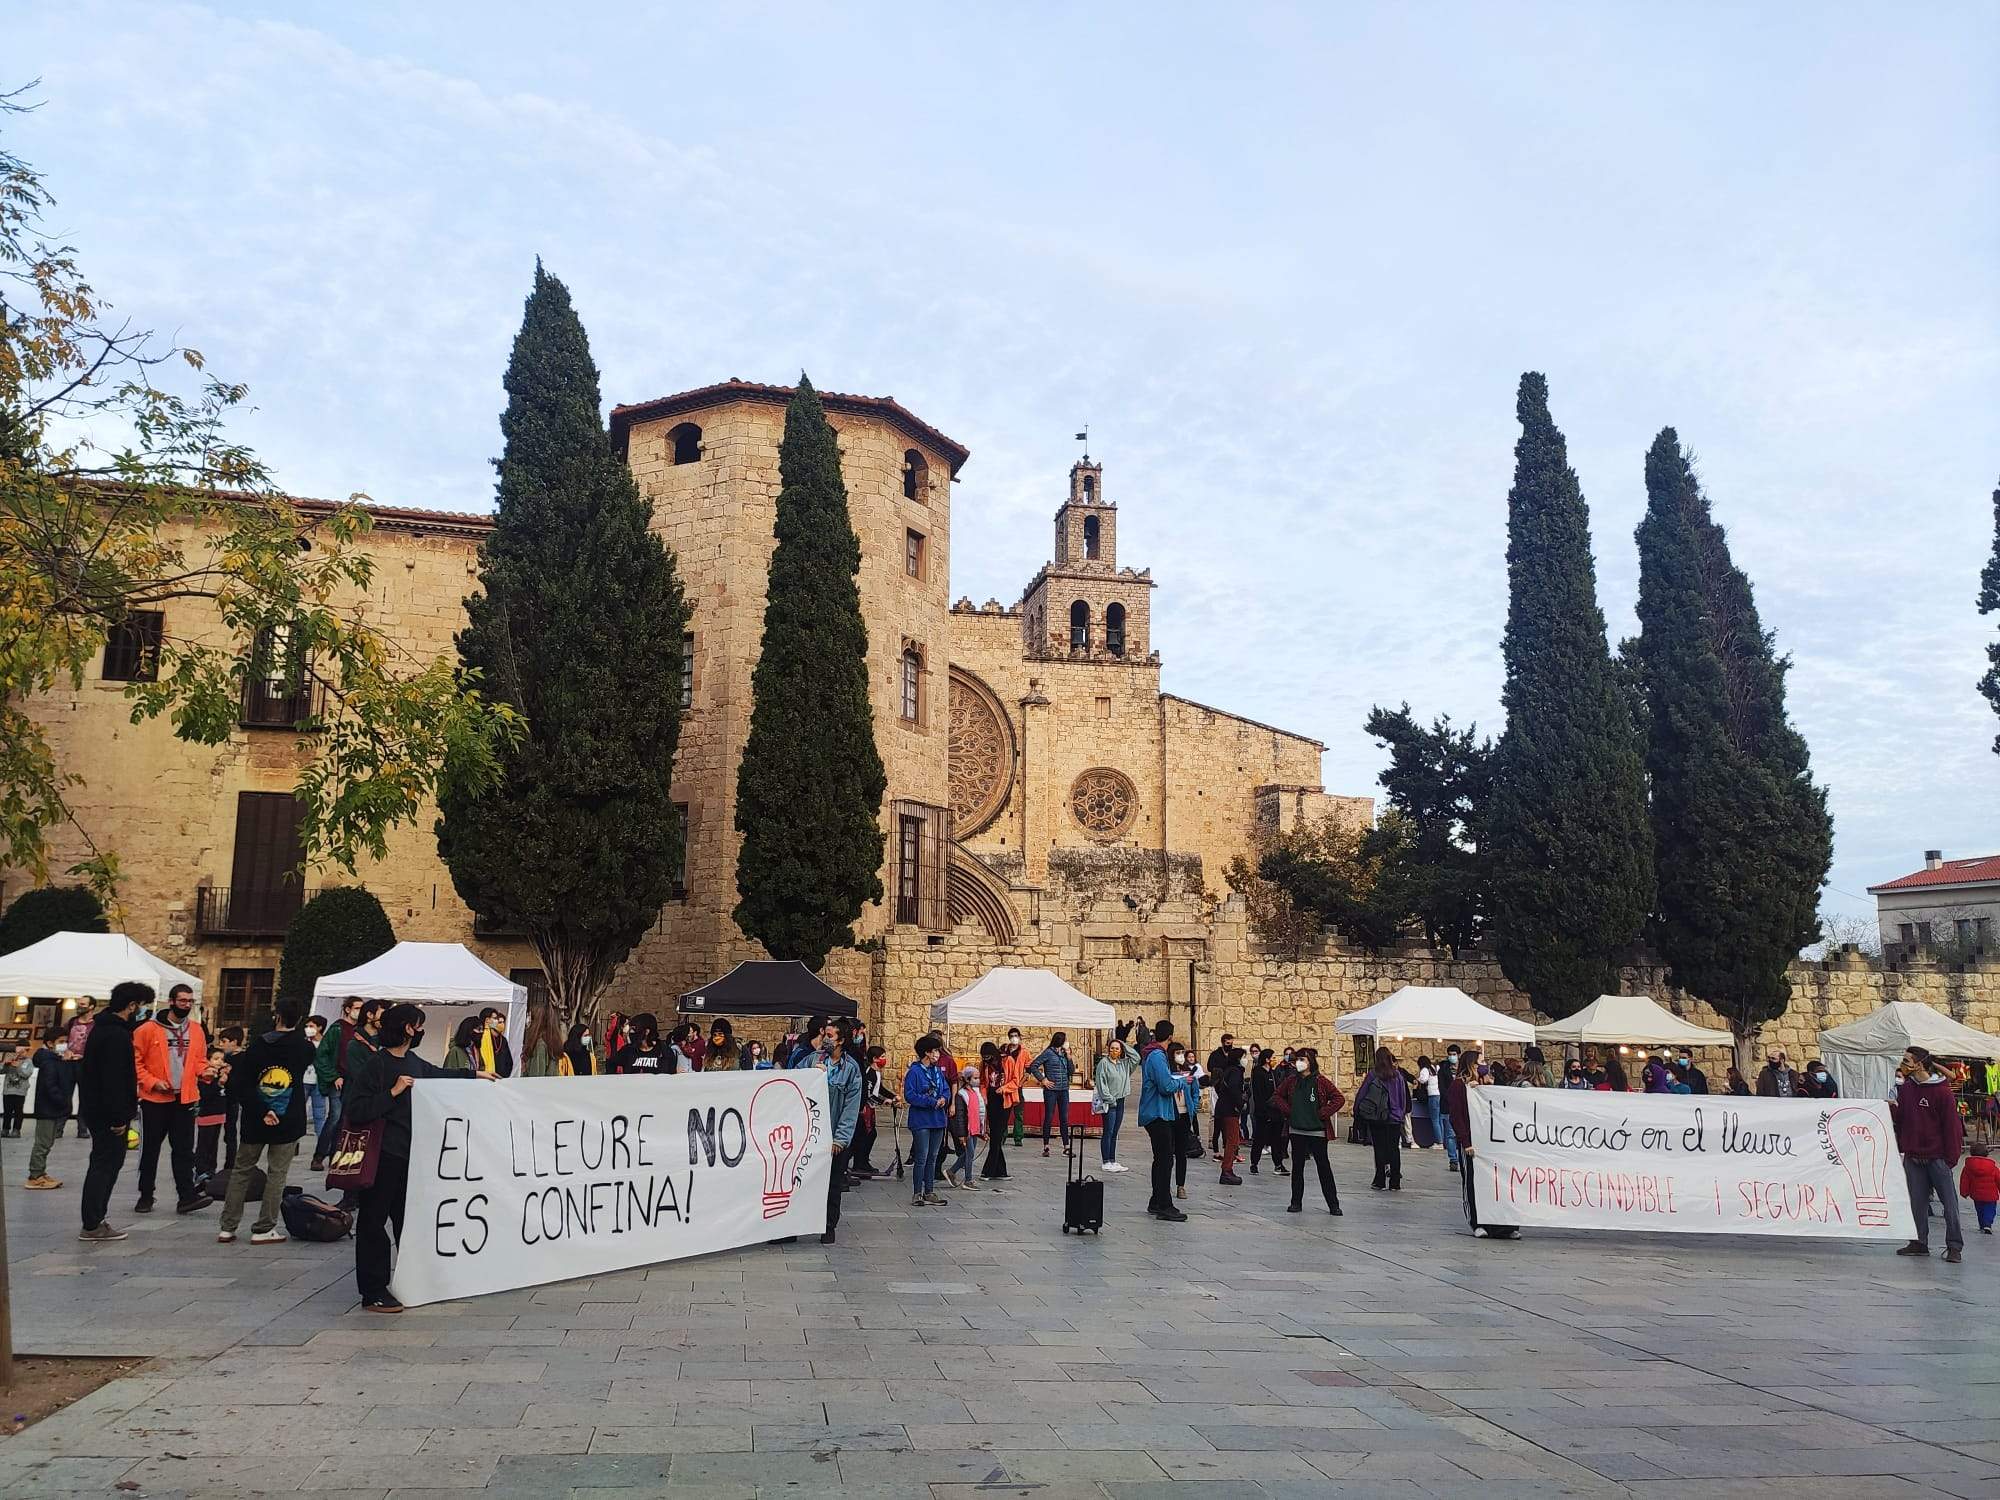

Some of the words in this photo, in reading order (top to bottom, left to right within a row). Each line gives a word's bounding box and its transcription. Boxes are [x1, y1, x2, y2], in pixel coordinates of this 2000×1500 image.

[806, 1096, 821, 1144] APLEC
[1488, 1100, 1632, 1152] L'educació
[1641, 1126, 1672, 1152] en
[1682, 1108, 1706, 1153] el
[1721, 1110, 1798, 1158] lleure
[1817, 1110, 1831, 1136] JOVE
[438, 1117, 484, 1182] EL
[509, 1114, 654, 1178] LLEURE
[687, 1106, 747, 1168] NO
[1820, 1137, 1842, 1166] APLEC
[793, 1147, 813, 1189] JOVE
[436, 1193, 489, 1257] ES
[522, 1169, 694, 1245] CONFINA!
[1738, 1180, 1843, 1224] SEGURA
